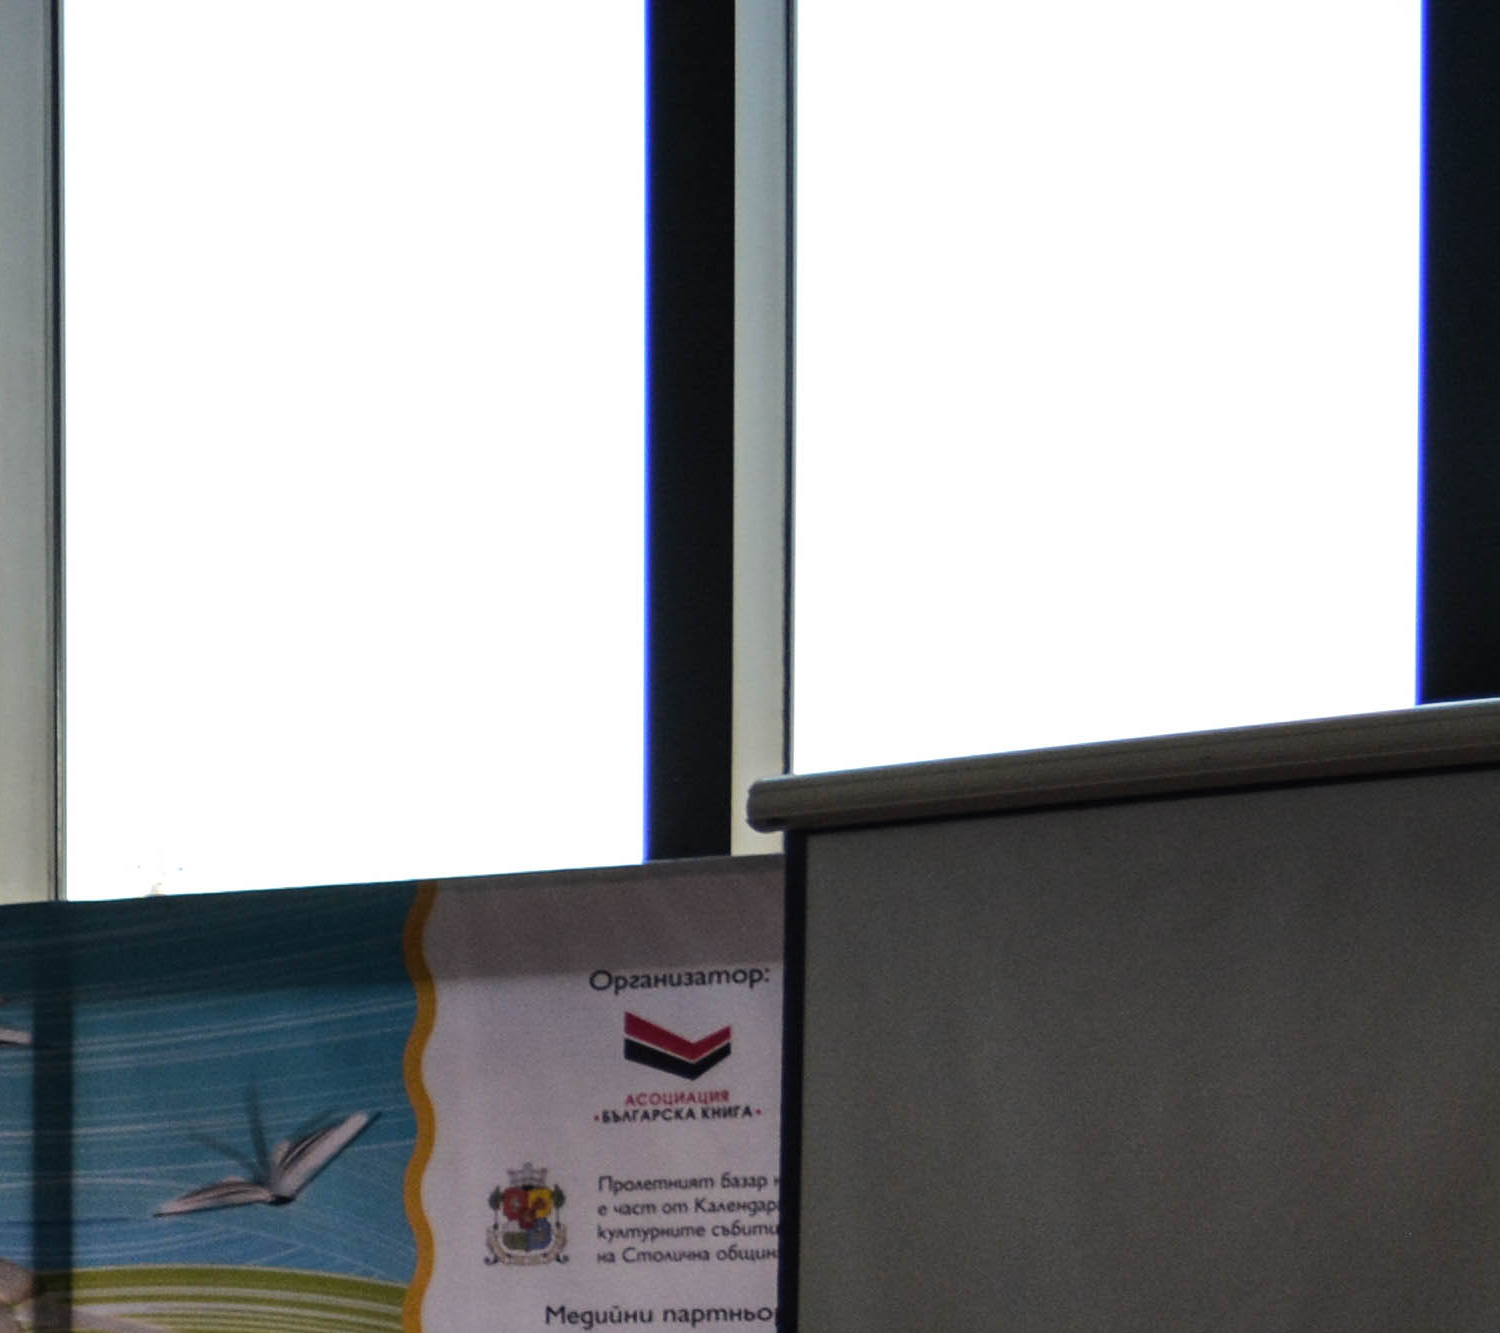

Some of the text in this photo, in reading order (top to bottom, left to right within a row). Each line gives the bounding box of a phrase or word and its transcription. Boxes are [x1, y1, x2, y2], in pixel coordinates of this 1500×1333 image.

[589, 966, 771, 995] Организатор:
[624, 1089, 730, 1107] АСОЦИАЦИЯ
[598, 1175, 715, 1197] Пролетният
[720, 1171, 769, 1192] базар
[597, 1205, 608, 1216] е
[613, 1202, 657, 1216] част
[662, 1202, 688, 1214] от
[712, 1218, 780, 1238] събити
[597, 1242, 780, 1264] на Столична общин
[545, 1304, 653, 1331] Медийни
